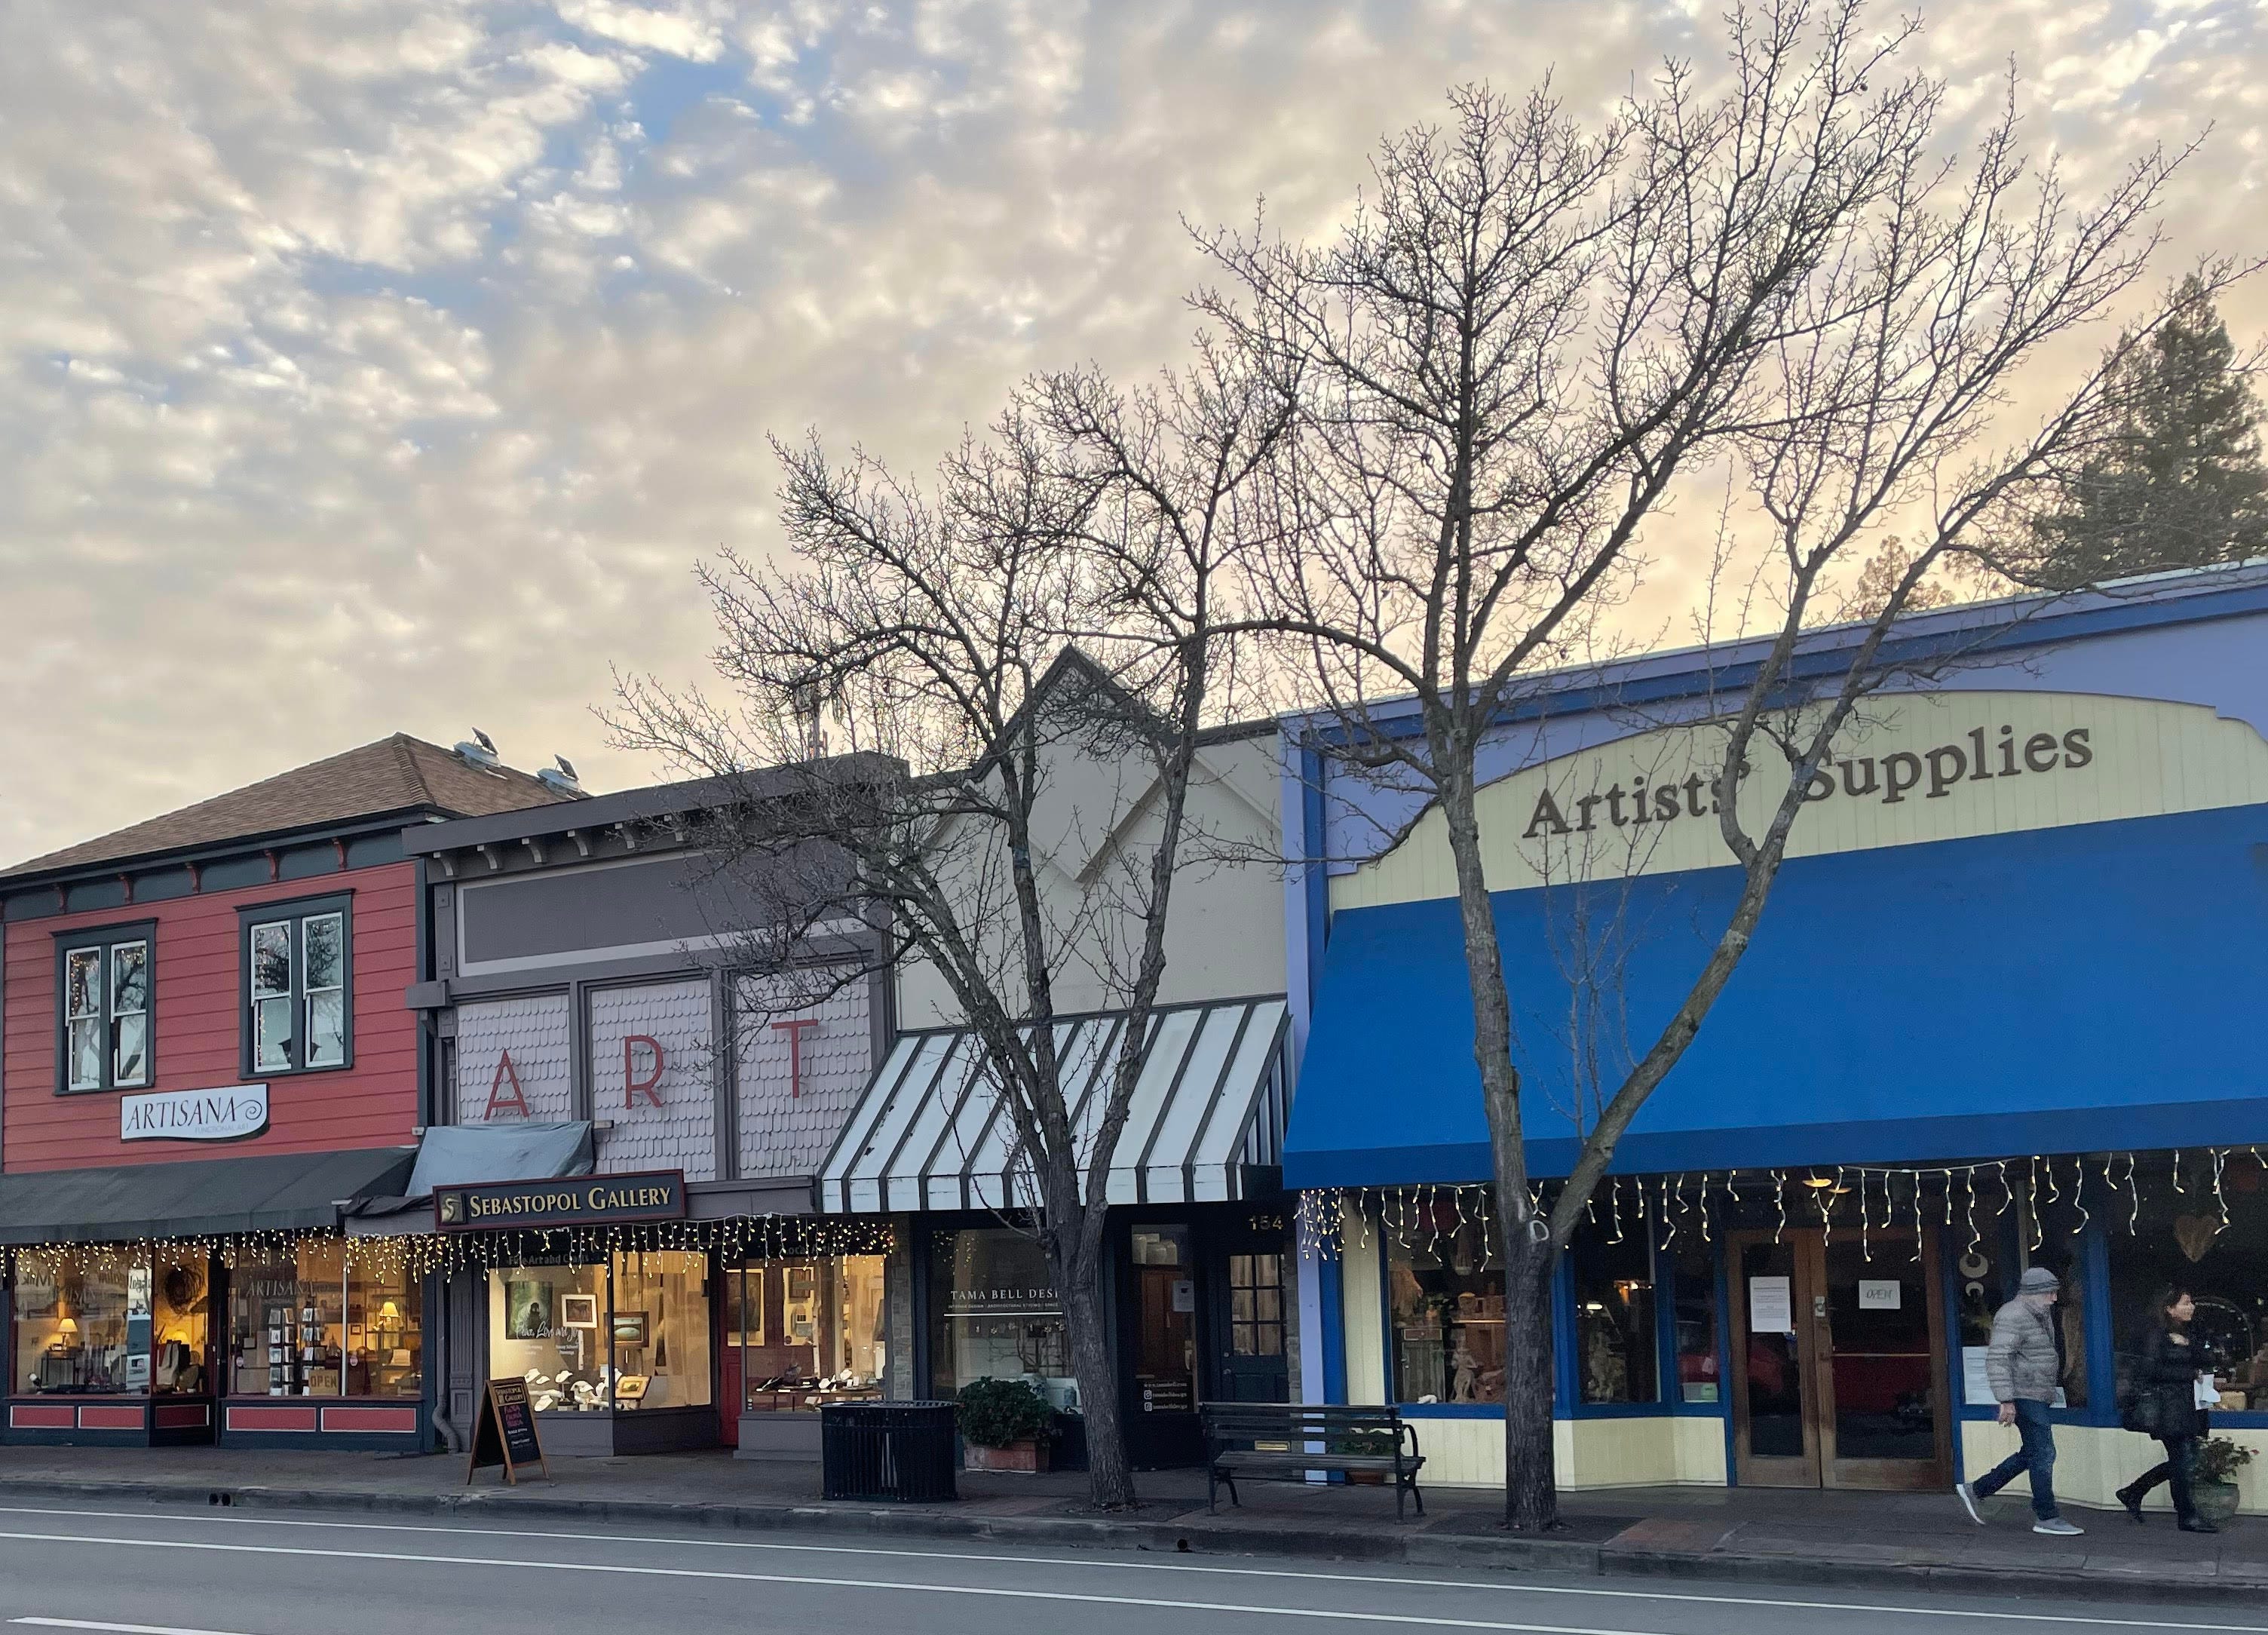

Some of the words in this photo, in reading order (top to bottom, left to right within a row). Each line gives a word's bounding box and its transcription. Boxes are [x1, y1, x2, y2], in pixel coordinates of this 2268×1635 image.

[1803, 724, 2093, 804] Supplies
[126, 1096, 237, 1131] ARTISANA
[470, 1193, 581, 1218] SEBASTOPOL
[588, 1186, 671, 1210] GALLERY
[1249, 1215, 1283, 1230] 154
[563, 1253, 590, 1263] Cats
[950, 1290, 986, 1300] TAMA
[991, 1289, 1023, 1299] BELL
[1028, 1288, 1059, 1299] DESI
[1866, 1288, 1893, 1300] OPEN
[310, 1375, 338, 1388] OPEN
